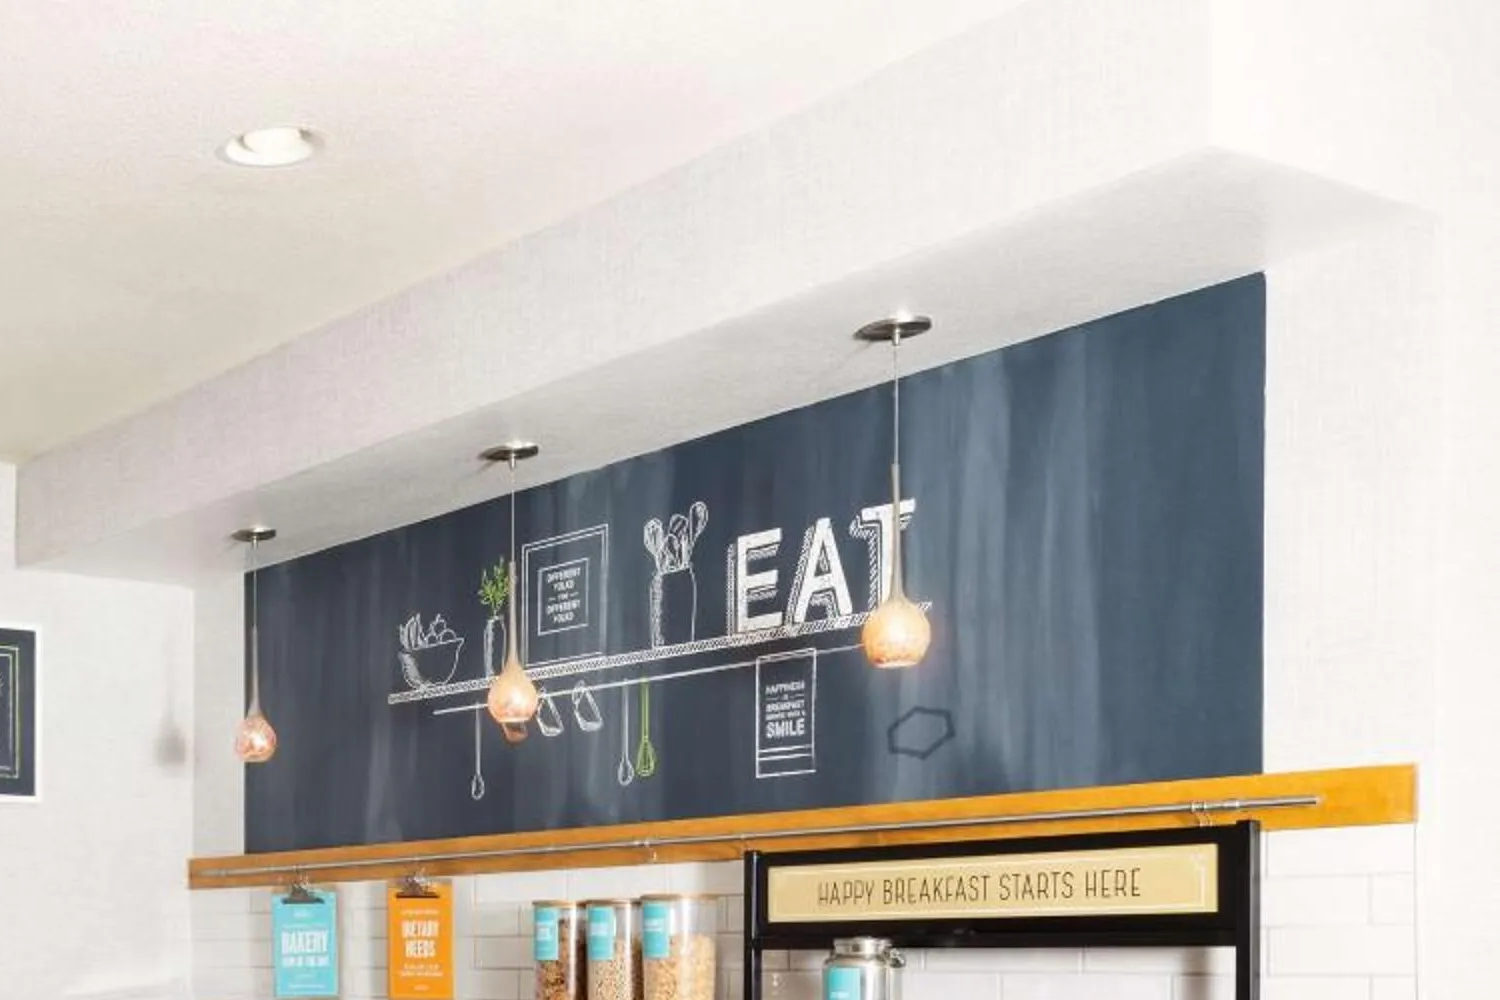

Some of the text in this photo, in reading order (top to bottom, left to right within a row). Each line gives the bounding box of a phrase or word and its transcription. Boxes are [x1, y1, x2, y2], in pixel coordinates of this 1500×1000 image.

[727, 498, 916, 634] EAT
[766, 718, 806, 740] SMILE
[818, 867, 1142, 906] HAPPY BREAKFAST STARTS HERE
[281, 929, 329, 955] BAKERY
[405, 939, 436, 958] NEEDS
